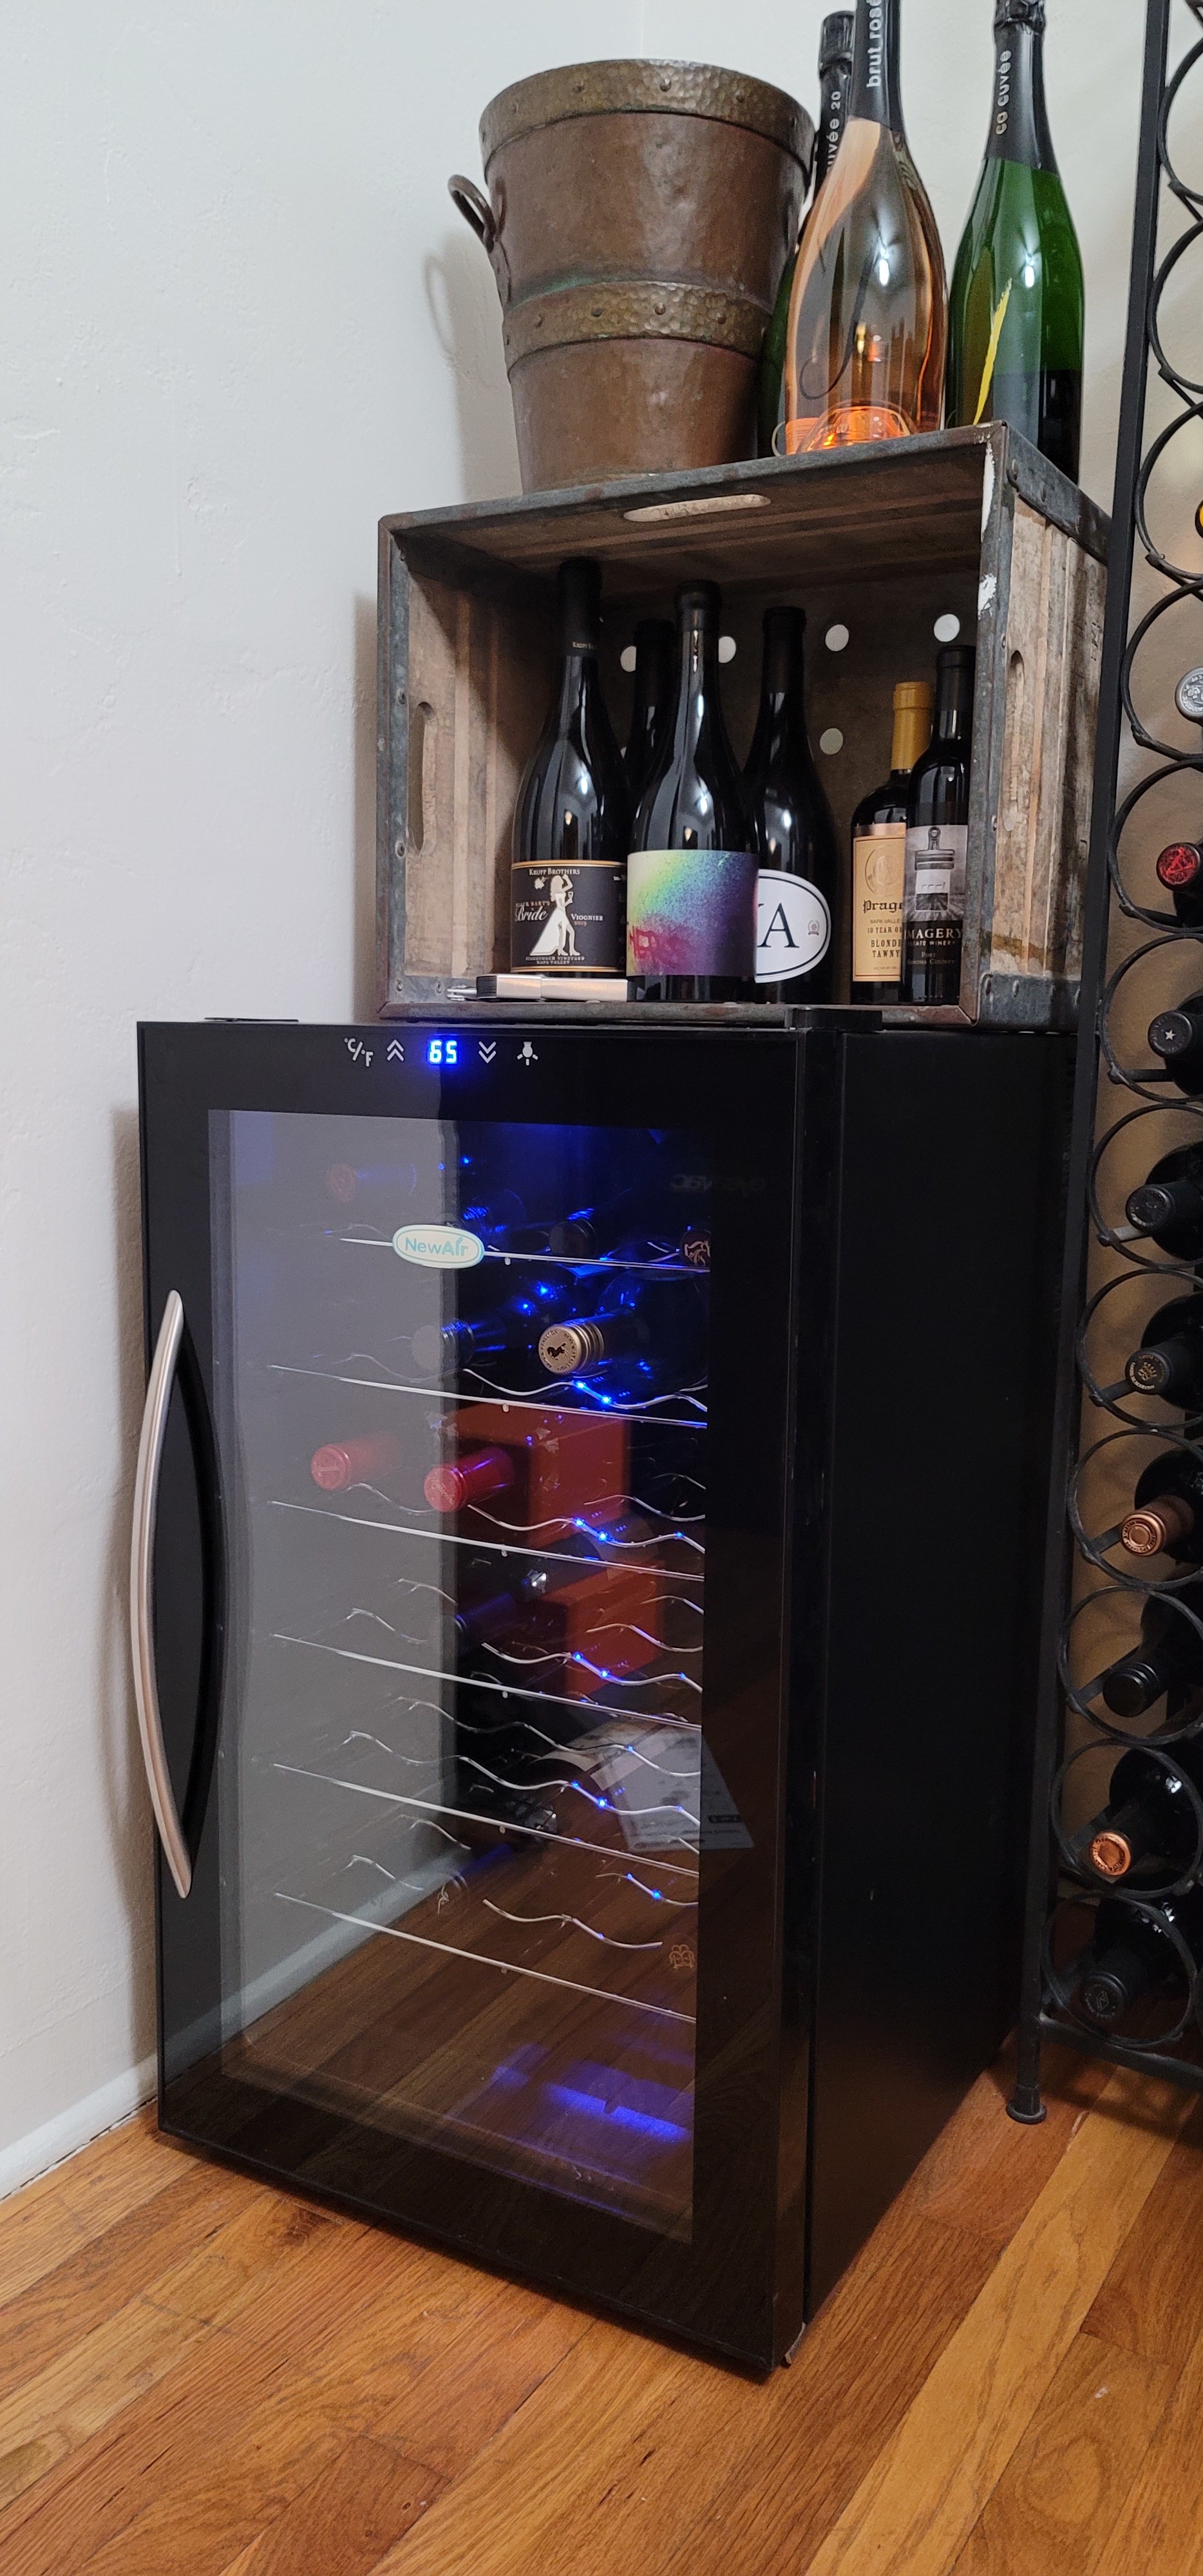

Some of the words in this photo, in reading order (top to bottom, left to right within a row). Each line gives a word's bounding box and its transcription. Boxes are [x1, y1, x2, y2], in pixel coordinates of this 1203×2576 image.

[866, 40, 883, 88] brut
[998, 50, 1012, 107] cuvée
[831, 91, 841, 110] 20
[826, 118, 840, 173] uvée
[547, 867, 580, 876] BROTHERS
[515, 905, 549, 922] Bride
[872, 949, 901, 958] TAWNY
[429, 1040, 457, 1063] 65
[404, 1236, 469, 1256] NewAir
